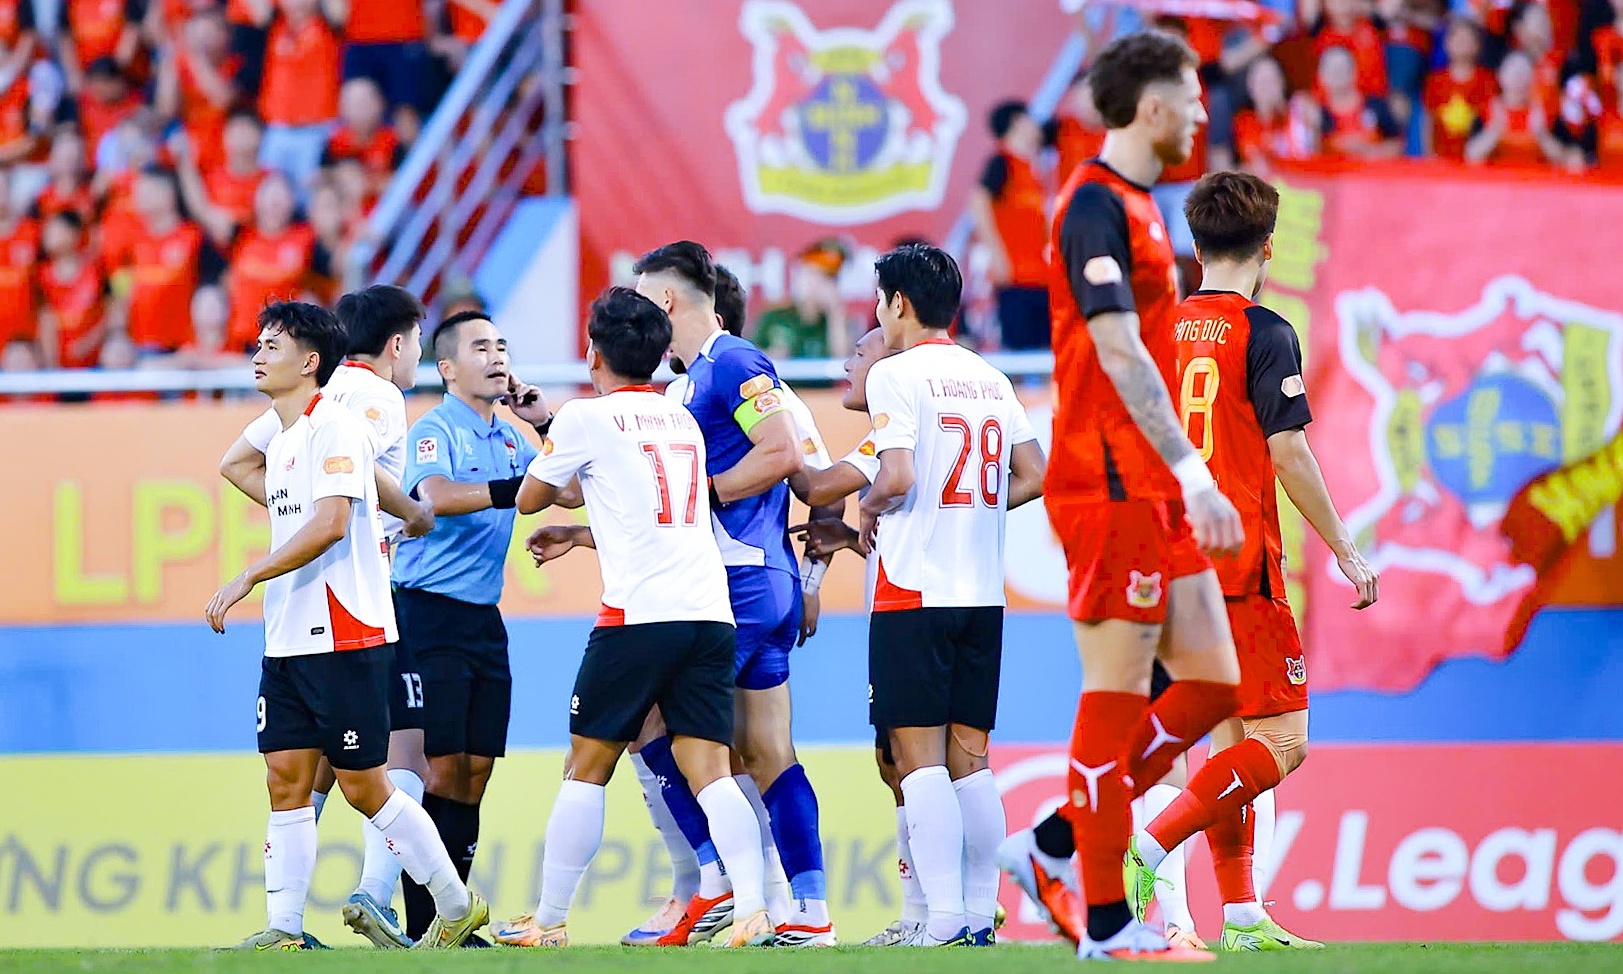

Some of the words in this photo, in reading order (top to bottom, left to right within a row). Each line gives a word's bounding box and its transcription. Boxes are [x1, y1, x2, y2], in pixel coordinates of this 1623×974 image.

[926, 379, 940, 398] T.
[613, 414, 631, 432] V.
[938, 413, 1003, 509] 28
[639, 441, 698, 528] 17
[401, 672, 425, 709] 13
